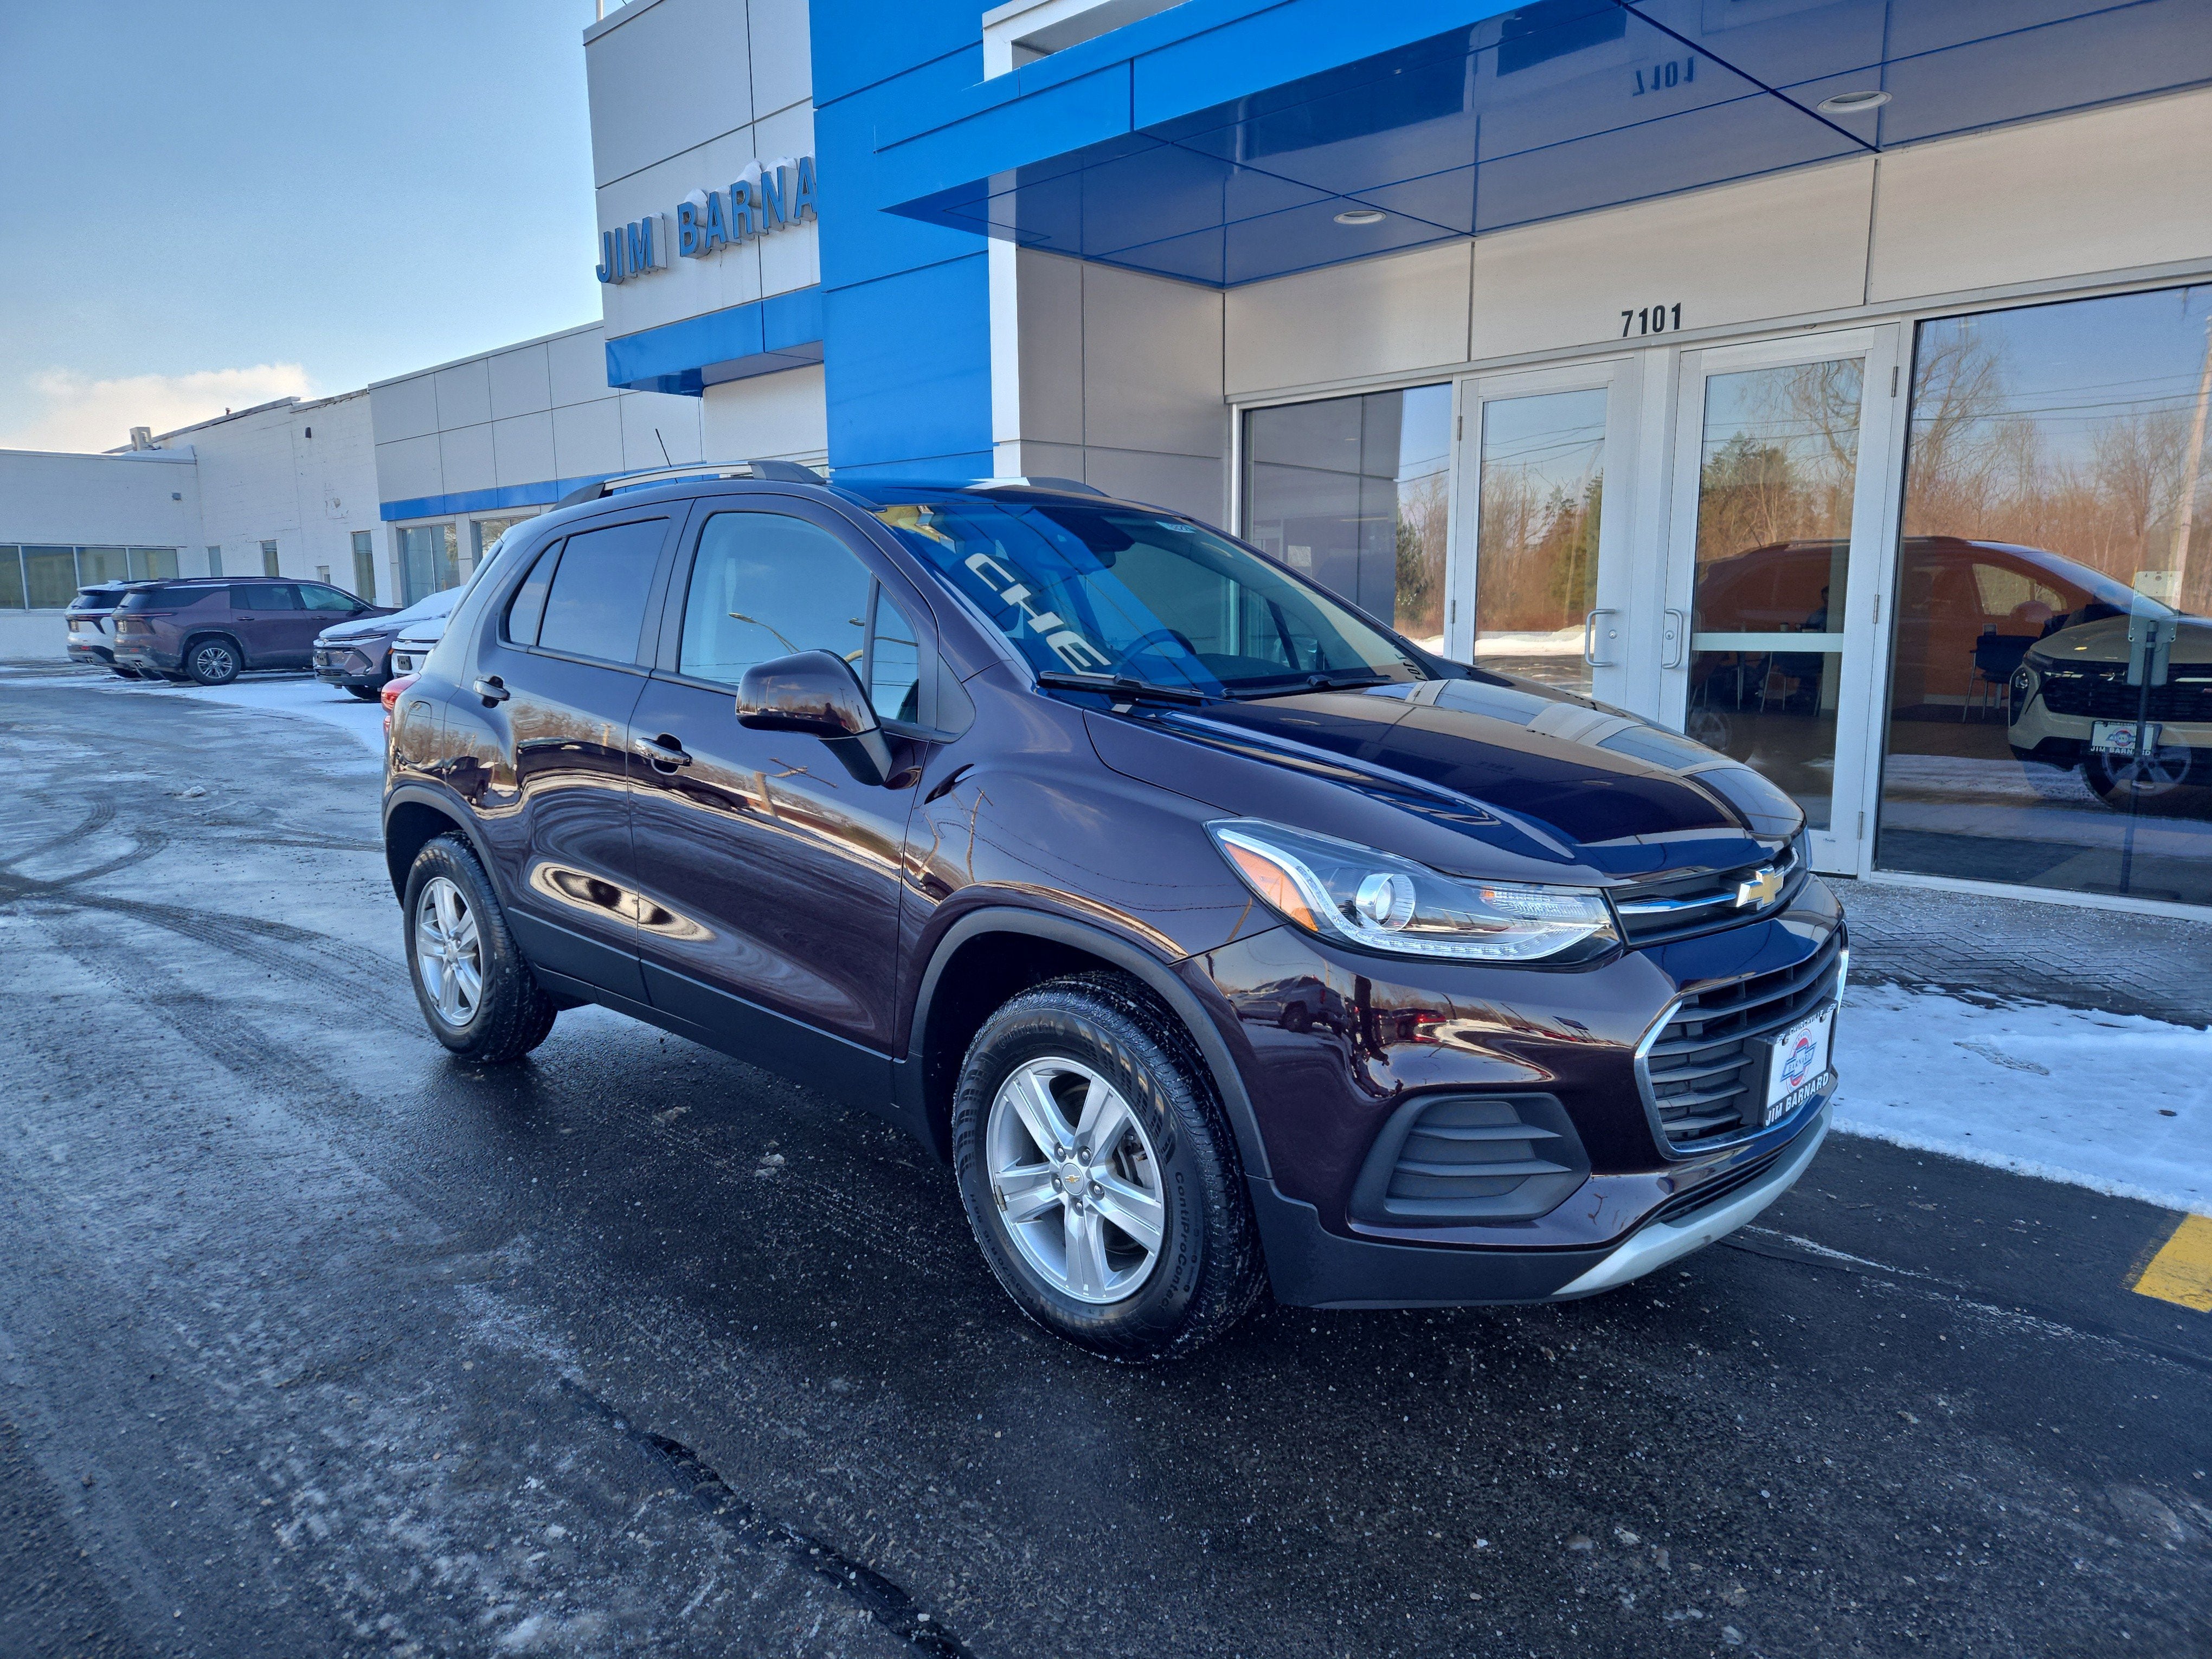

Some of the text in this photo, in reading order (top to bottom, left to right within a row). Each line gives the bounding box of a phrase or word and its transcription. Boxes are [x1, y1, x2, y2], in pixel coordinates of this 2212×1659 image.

[596, 156, 817, 284] JIM BARNA
[1621, 302, 1681, 337] 7101
[1765, 1102, 1783, 1127] JIM
[1785, 1072, 1829, 1112] BARNARD
